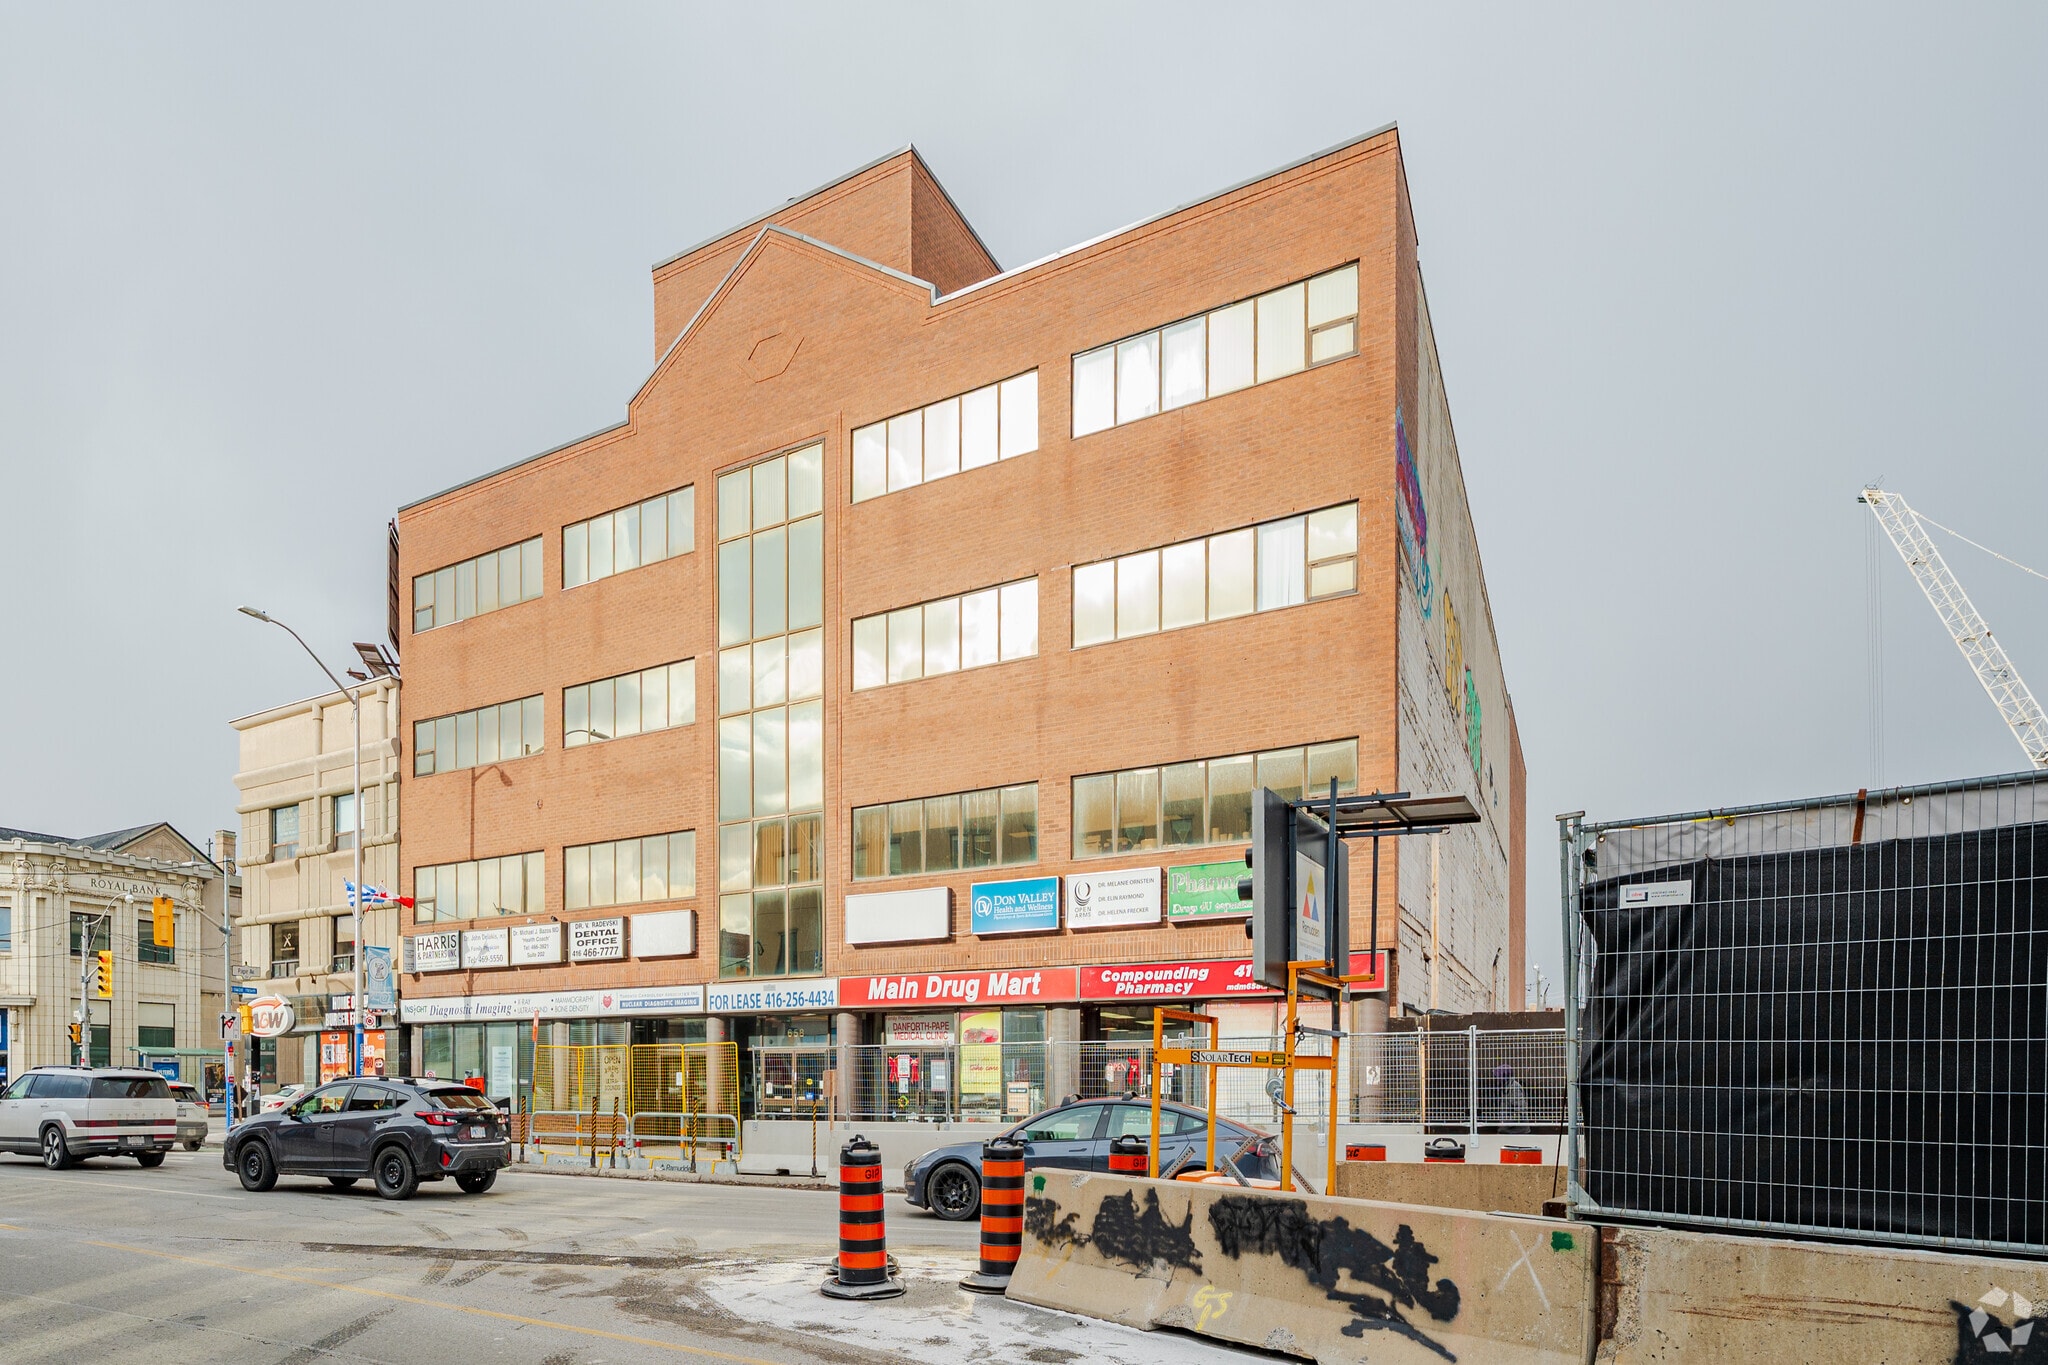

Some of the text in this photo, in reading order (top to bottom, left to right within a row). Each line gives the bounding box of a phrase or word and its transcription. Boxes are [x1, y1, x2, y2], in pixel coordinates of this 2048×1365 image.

[90, 878, 161, 896] ROYAL BANK
[1171, 871, 1252, 894] Pharm
[993, 892, 1055, 906] DON VALLEY
[993, 903, 1054, 914] Health and Wellness
[575, 929, 619, 938] DENTAL
[417, 934, 457, 951] HARRIS
[576, 937, 617, 947] OFFICE
[422, 950, 448, 960] PARTNERS
[583, 946, 619, 957] 466-7777
[1100, 966, 1210, 983] Compounding
[867, 972, 1042, 1003] Main Drug Mart
[1115, 981, 1194, 995] Pharmacy
[709, 990, 834, 1010] FOR LEASE 416-256-4434
[429, 1003, 472, 1017] Diagnostic
[475, 1002, 512, 1016] Imaging
[892, 1021, 950, 1031] DANFORTH-PAPE
[894, 1031, 949, 1041] MEDICAL CLINIC
[865, 1168, 880, 1179] GIP
